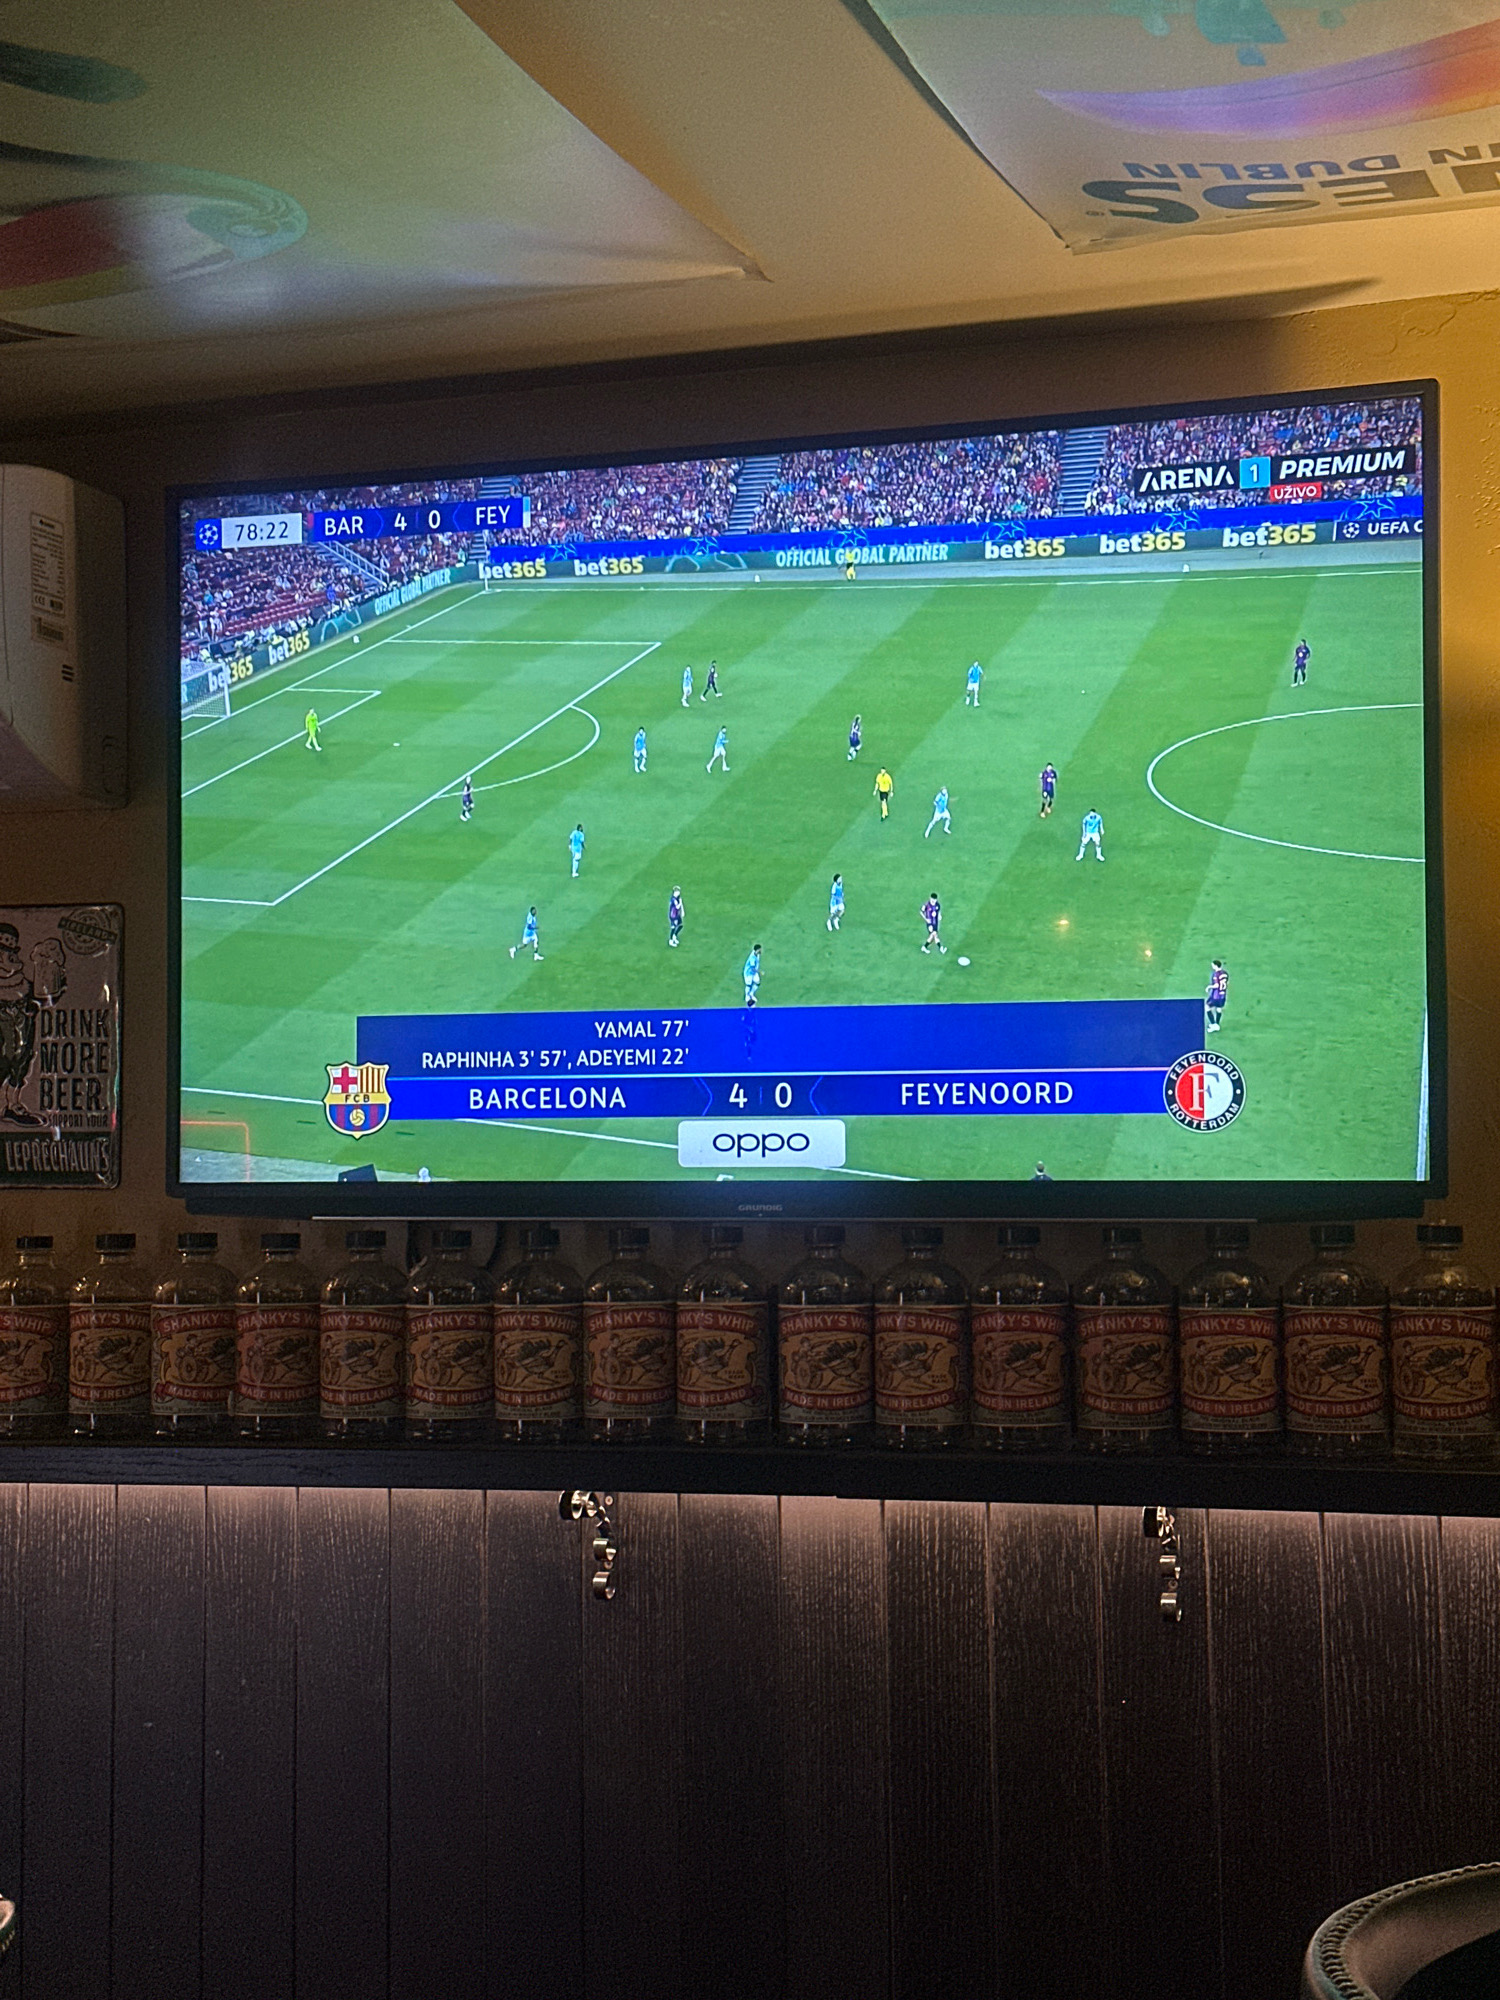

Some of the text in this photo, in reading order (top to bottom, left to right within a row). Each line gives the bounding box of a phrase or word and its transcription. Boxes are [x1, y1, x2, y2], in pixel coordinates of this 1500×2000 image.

[1122, 154, 1401, 180] DUBLIN
[1139, 450, 1406, 492] ARENA 1 PREMIUM
[1273, 483, 1317, 500] UŽIVO
[234, 521, 289, 541] 78:22
[324, 505, 511, 536] BAR 4 0 FEY
[1367, 522, 1410, 535] UEFA
[1100, 532, 1186, 554] bet365
[1222, 523, 1317, 548] bet365
[776, 548, 831, 567] OFFICIAL
[889, 544, 949, 563] PARTNER
[984, 538, 1066, 559] bet365
[478, 560, 547, 580] bet365
[574, 556, 644, 577] bet365
[267, 630, 311, 667] bet365
[40, 1008, 110, 1038] DRINK
[594, 1020, 690, 1039] YAMAL 77'
[40, 1042, 109, 1074] MORE
[421, 1051, 515, 1069] RAPHINHA
[518, 1050, 535, 1068] 3'
[576, 1048, 656, 1067] ADEYEMI
[661, 1047, 690, 1065] 22'
[1169, 1053, 1240, 1081] FEYENOORD
[39, 1077, 108, 1112] BEER.
[468, 1081, 1074, 1110] BARCELONA 4 0 FEYENOORD
[1169, 1102, 1240, 1130] ROTTERDAM
[712, 1131, 811, 1158] oppo
[5, 1139, 110, 1173] LEPRECHAUNS
[738, 1204, 784, 1213] GRUNDIG
[19, 1316, 51, 1331] WHIP
[163, 1312, 230, 1333] SHANKY'S
[238, 1311, 300, 1331] SHANKY'S
[411, 1315, 476, 1334] SHANKY'S
[544, 1316, 577, 1332] WHIP
[589, 1311, 656, 1331] SHANKY'S
[718, 1315, 754, 1332] WHIP
[781, 1315, 847, 1334] SHANKY'S
[920, 1316, 958, 1334] WHIP
[1081, 1316, 1151, 1336] SHANKY'S
[702, 1388, 746, 1404] IRELAND
[901, 1392, 950, 1409] IRELAND
[1437, 1400, 1487, 1418] IRELAND
